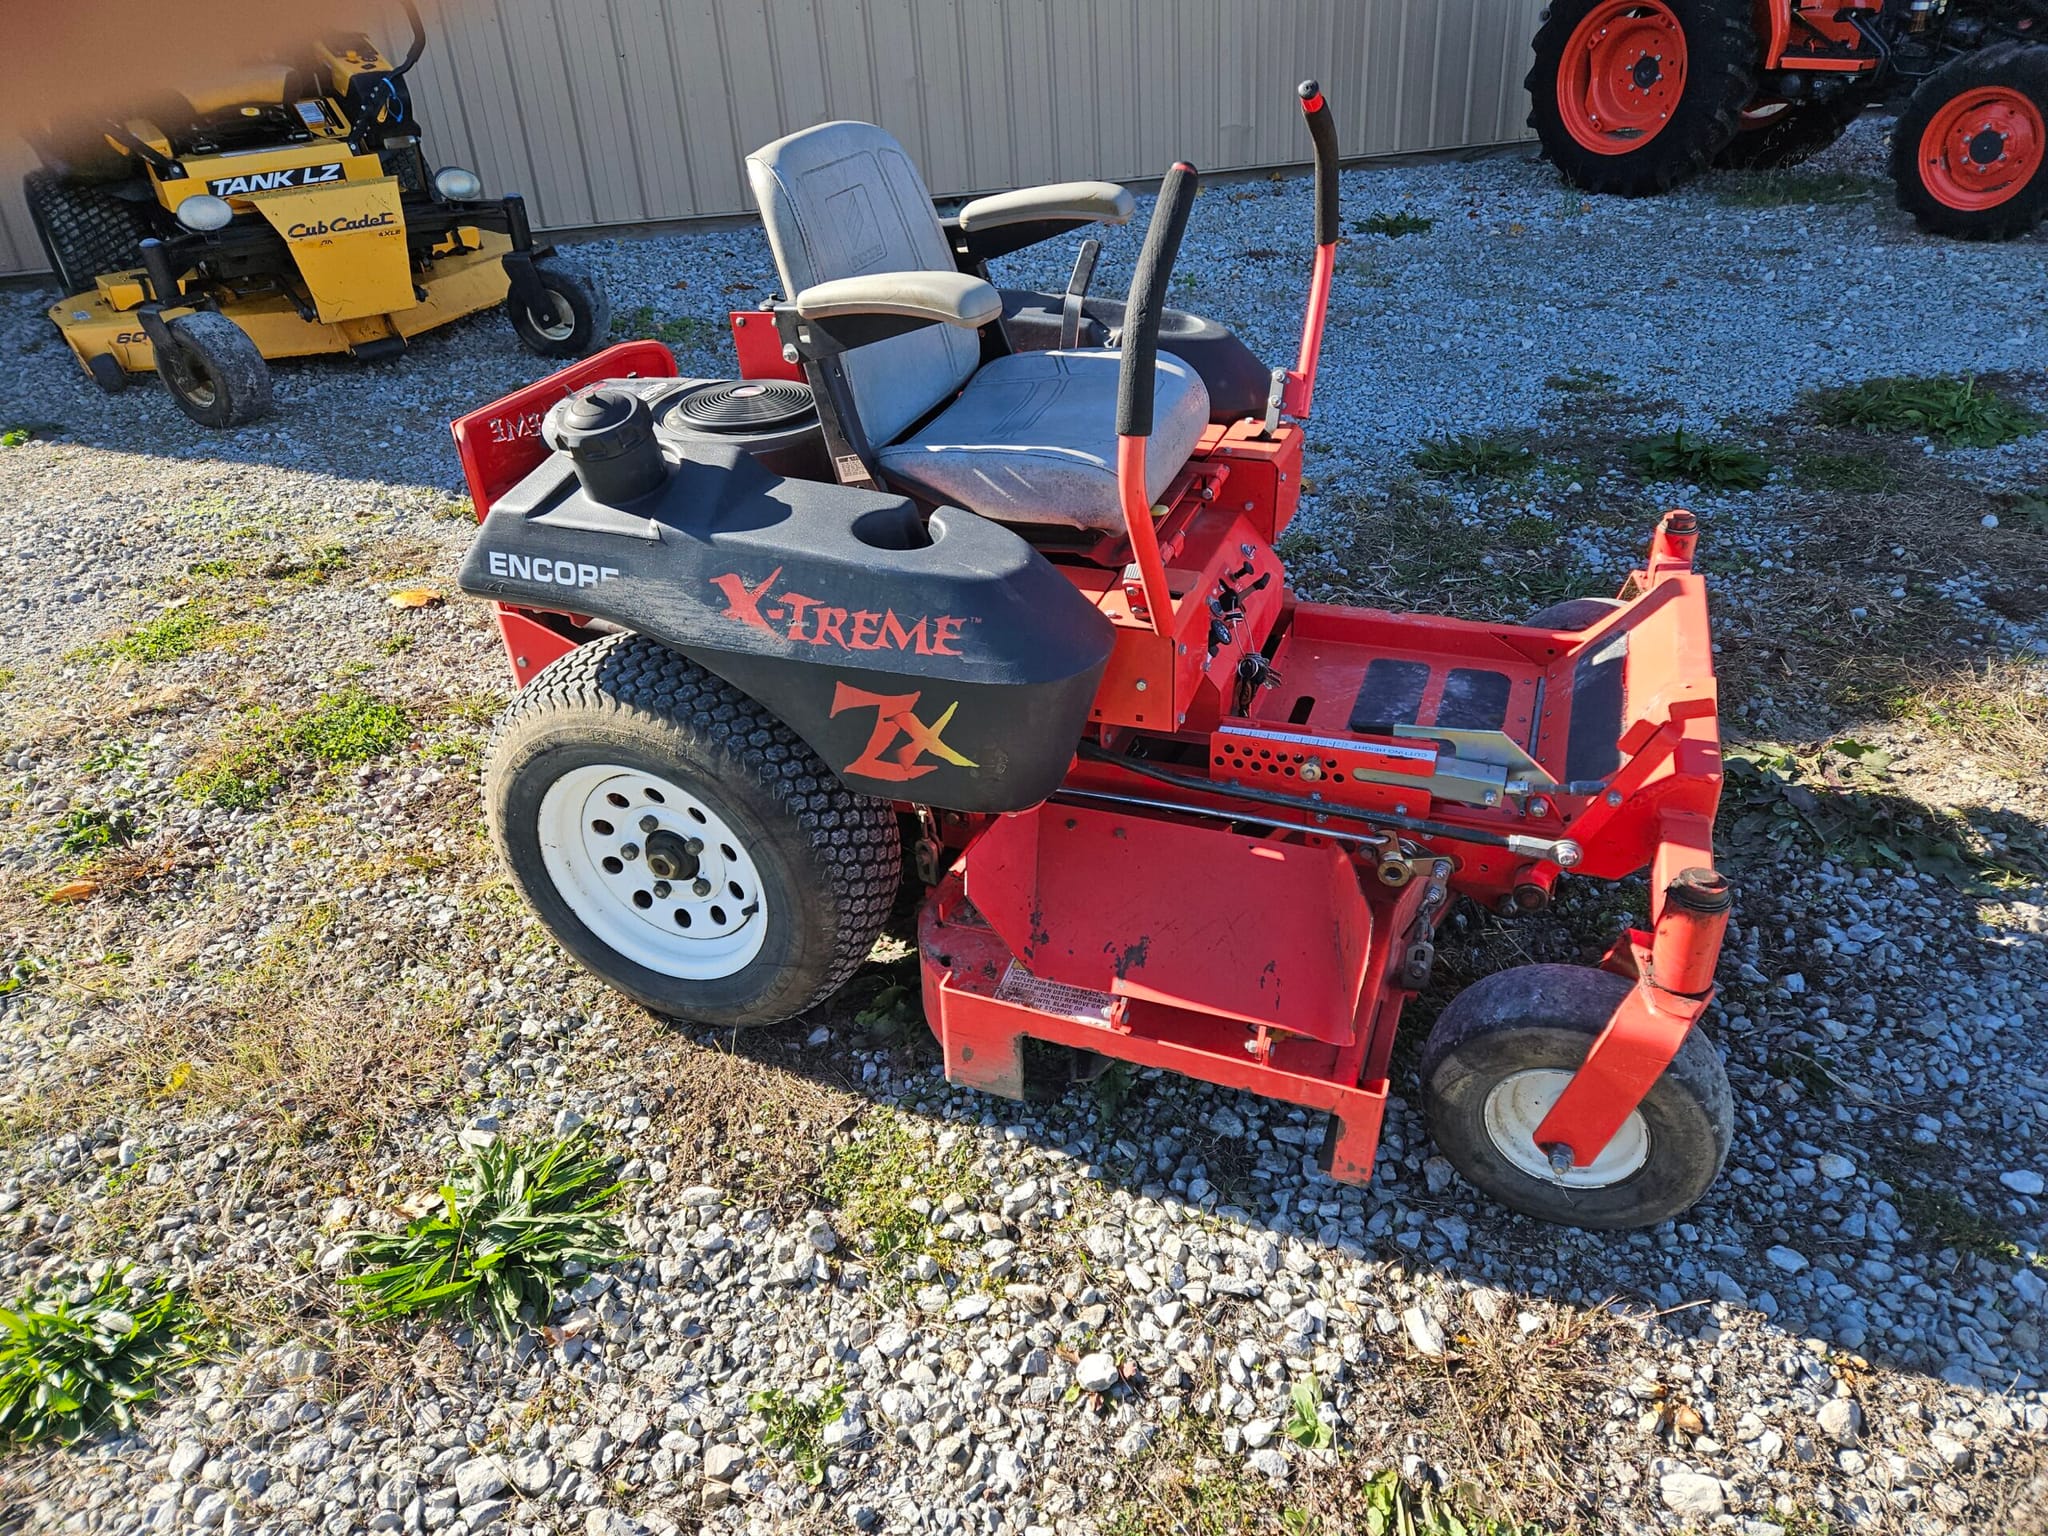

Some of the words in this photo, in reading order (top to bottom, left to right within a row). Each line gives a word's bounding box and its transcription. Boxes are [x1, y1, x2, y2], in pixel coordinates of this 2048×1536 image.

[212, 169, 295, 196] TANK
[303, 163, 340, 184] LZ
[288, 220, 329, 239] Cub
[330, 212, 394, 232] Cadet
